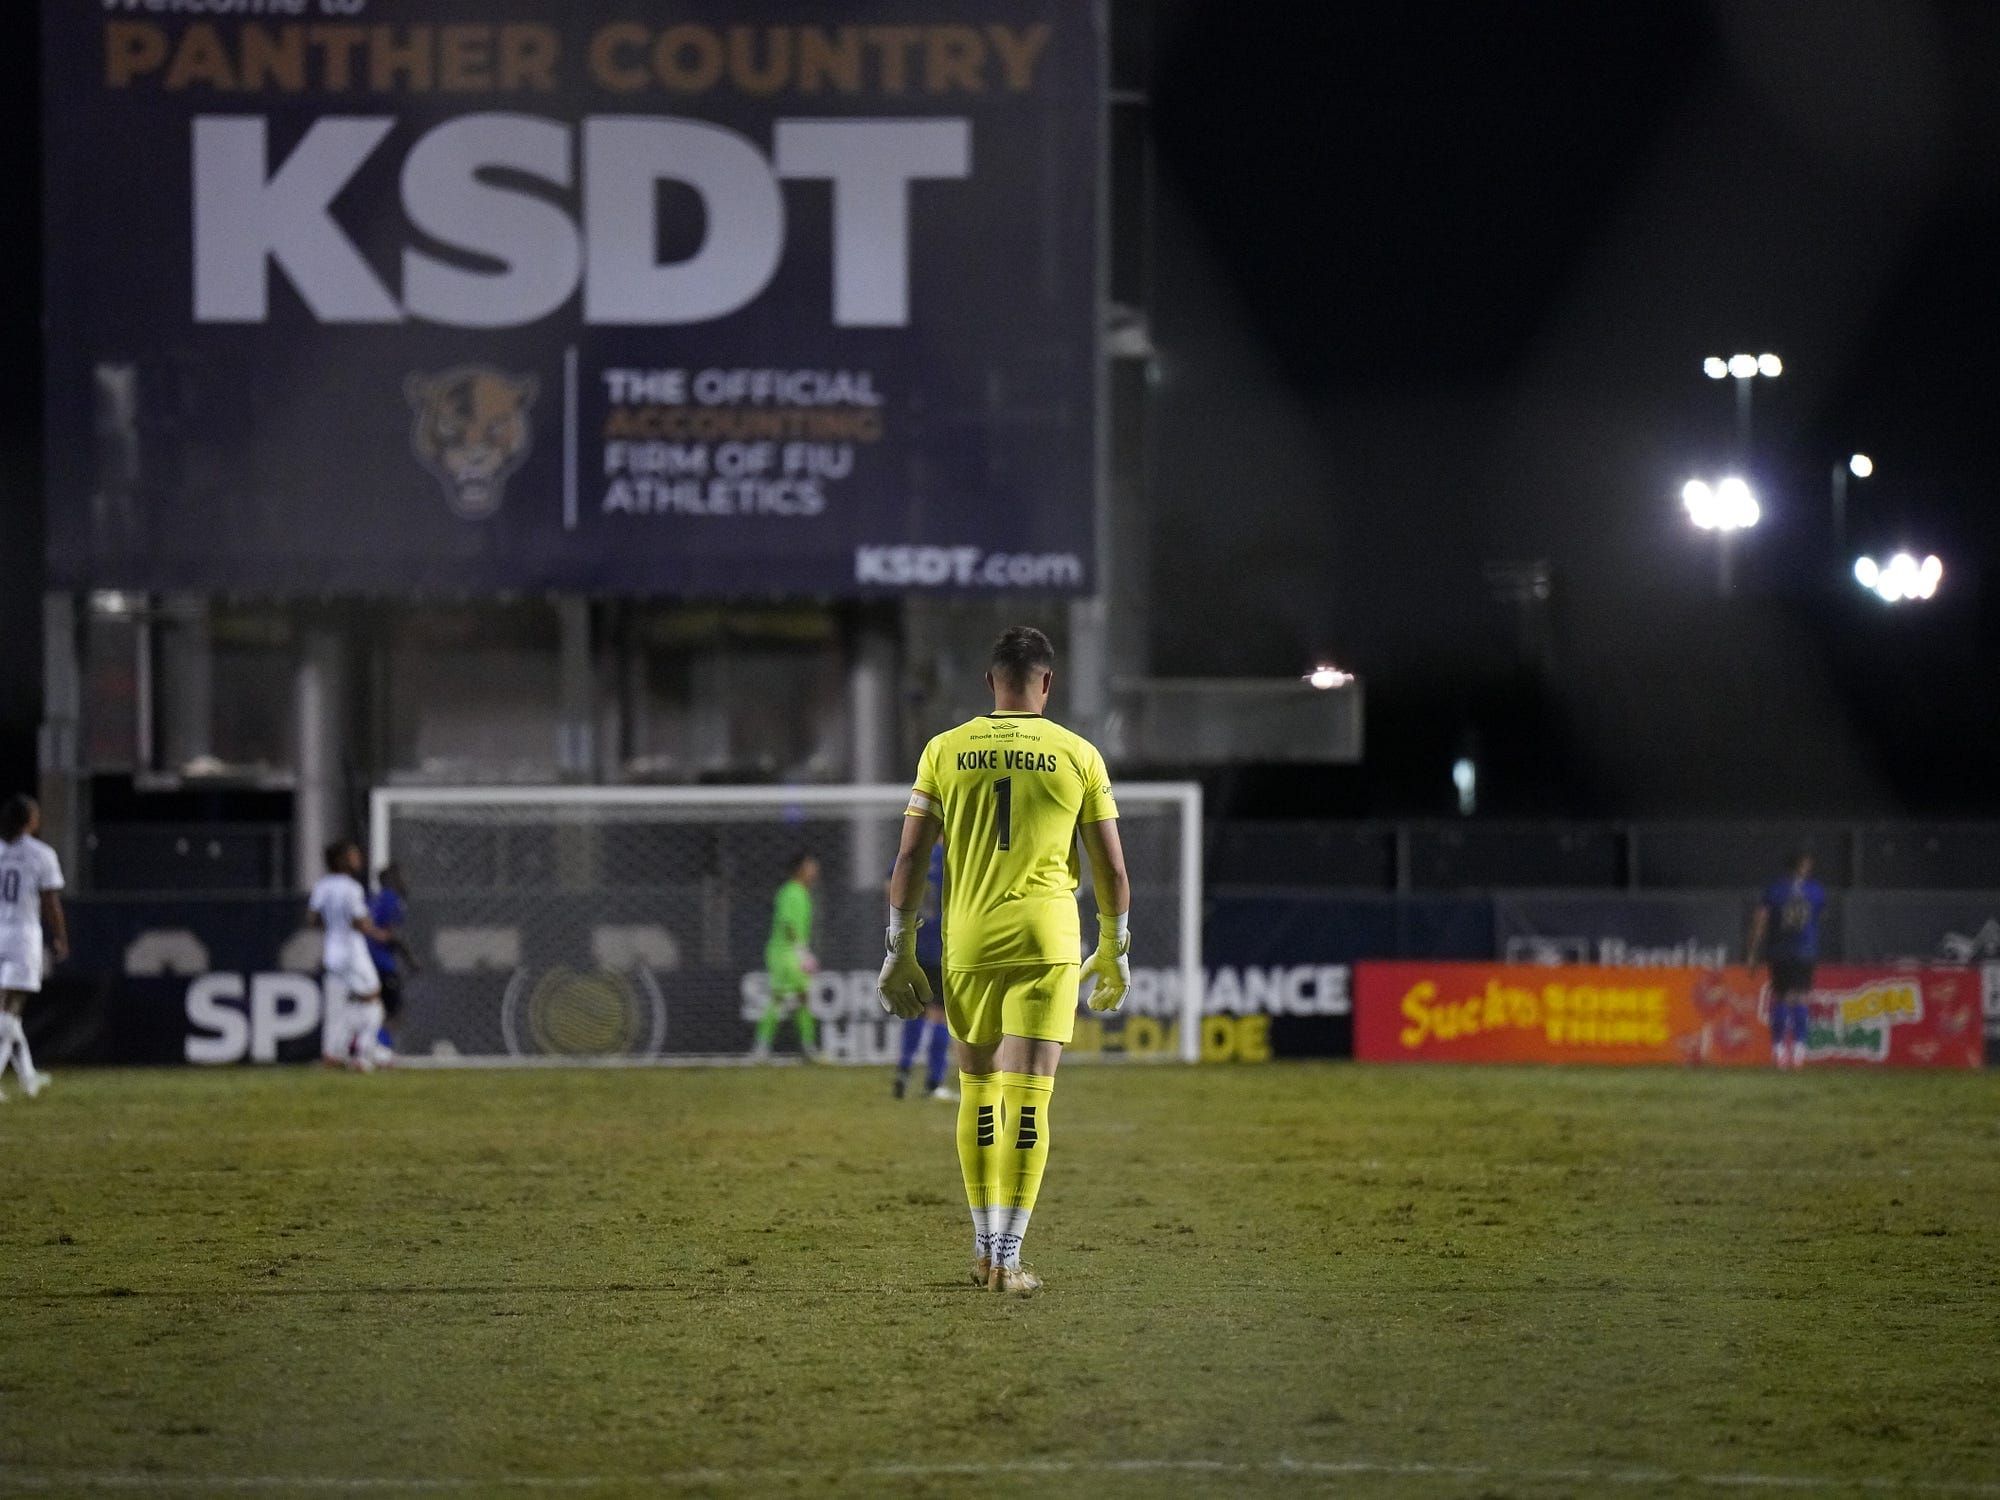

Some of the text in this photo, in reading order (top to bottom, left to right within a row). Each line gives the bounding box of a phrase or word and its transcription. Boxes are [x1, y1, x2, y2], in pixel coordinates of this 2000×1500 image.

[102, 23, 1050, 93] PANTHER COUNTRY
[192, 112, 972, 328] KSDT
[604, 369, 883, 406] THE OFFICIAL
[603, 441, 855, 479] FIRM OF FIU
[601, 478, 827, 516] ATHLETICS
[855, 546, 1082, 586] KSDT.com
[1015, 731, 1041, 742] Energy
[957, 750, 1057, 773] KOKE VEGAS
[993, 776, 1011, 851] 1
[1543, 983, 1666, 1012] SOME
